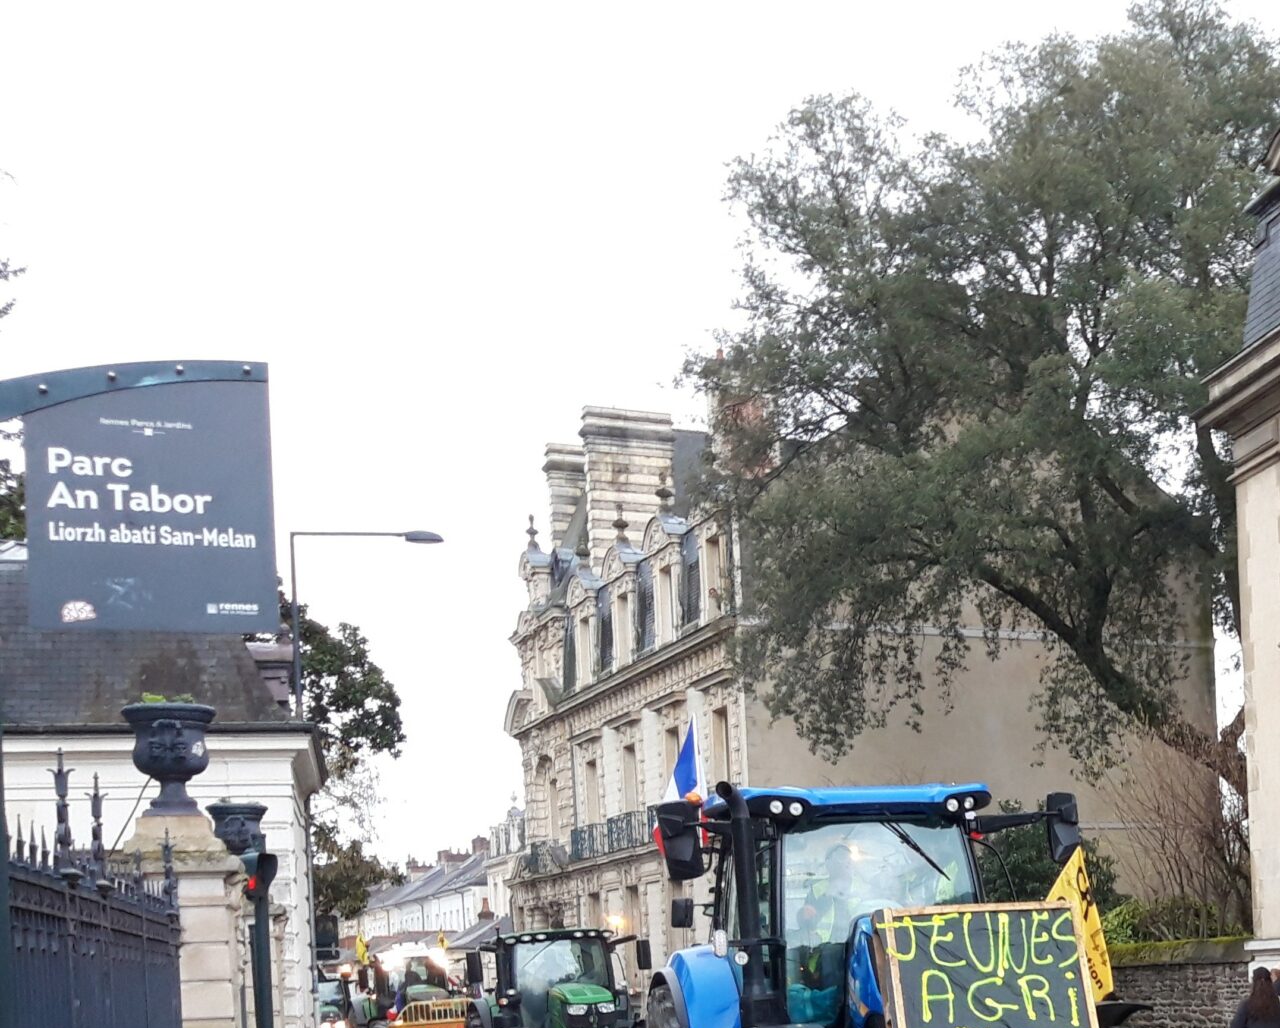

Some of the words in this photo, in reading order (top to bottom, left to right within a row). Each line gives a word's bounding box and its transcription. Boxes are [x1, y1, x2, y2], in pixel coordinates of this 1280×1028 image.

[47, 447, 133, 477] Parc
[47, 481, 98, 510] An
[106, 483, 212, 514] Tabor
[49, 521, 105, 542] Liorzh
[109, 523, 156, 545] abati
[159, 525, 256, 549] San-Melan
[219, 603, 258, 611] rennes
[877, 912, 1079, 976] JEUNES
